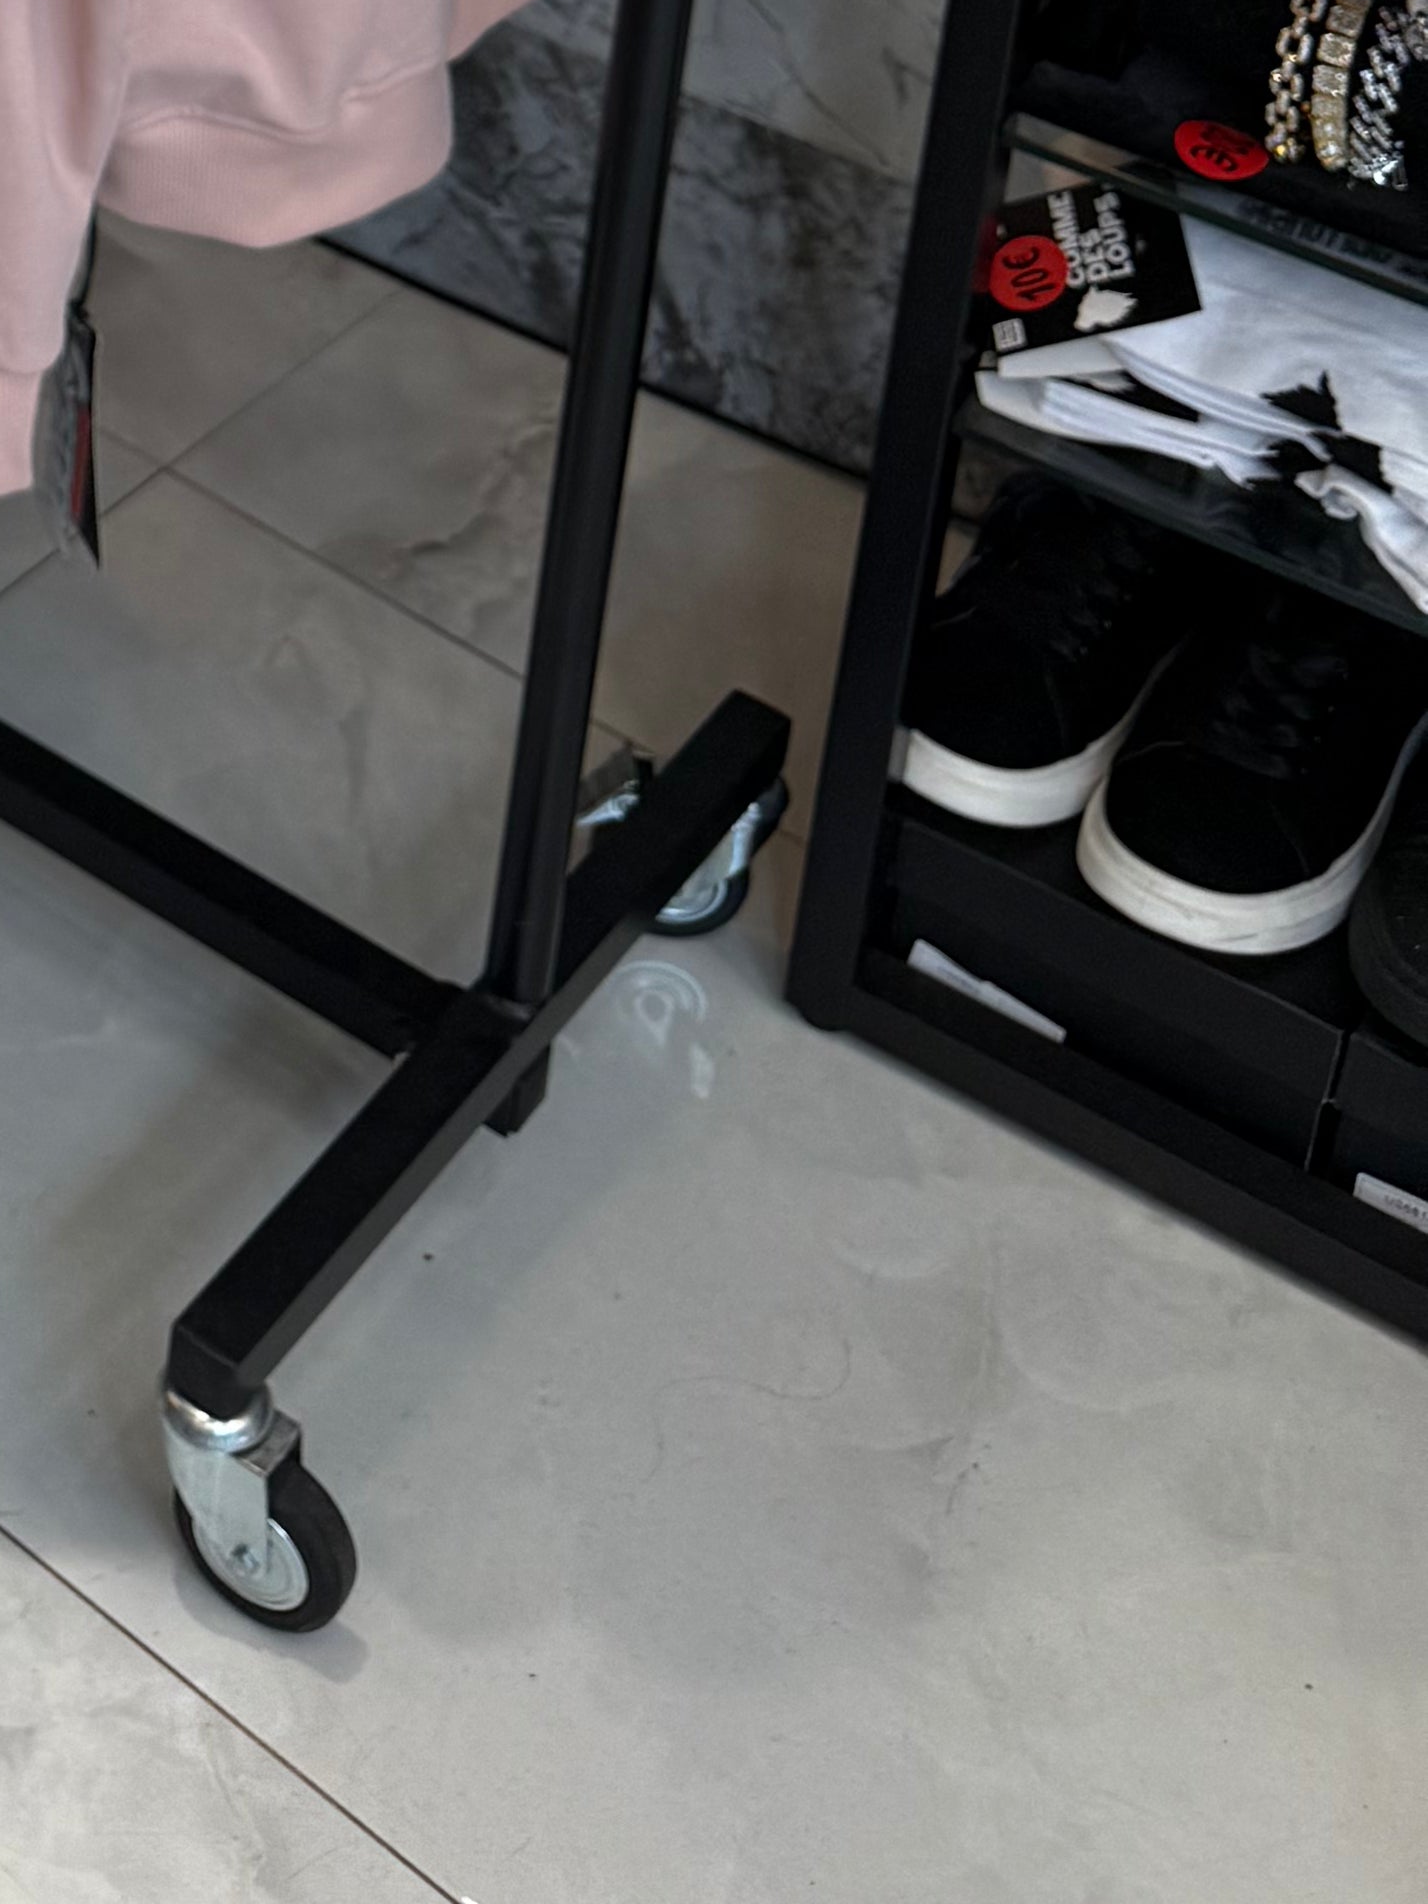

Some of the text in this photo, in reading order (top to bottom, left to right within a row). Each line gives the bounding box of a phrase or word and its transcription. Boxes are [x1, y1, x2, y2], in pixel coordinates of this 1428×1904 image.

[1078, 227, 1110, 285] DES
[1093, 190, 1135, 280] LOUPS
[1002, 245, 1055, 302] 10€
